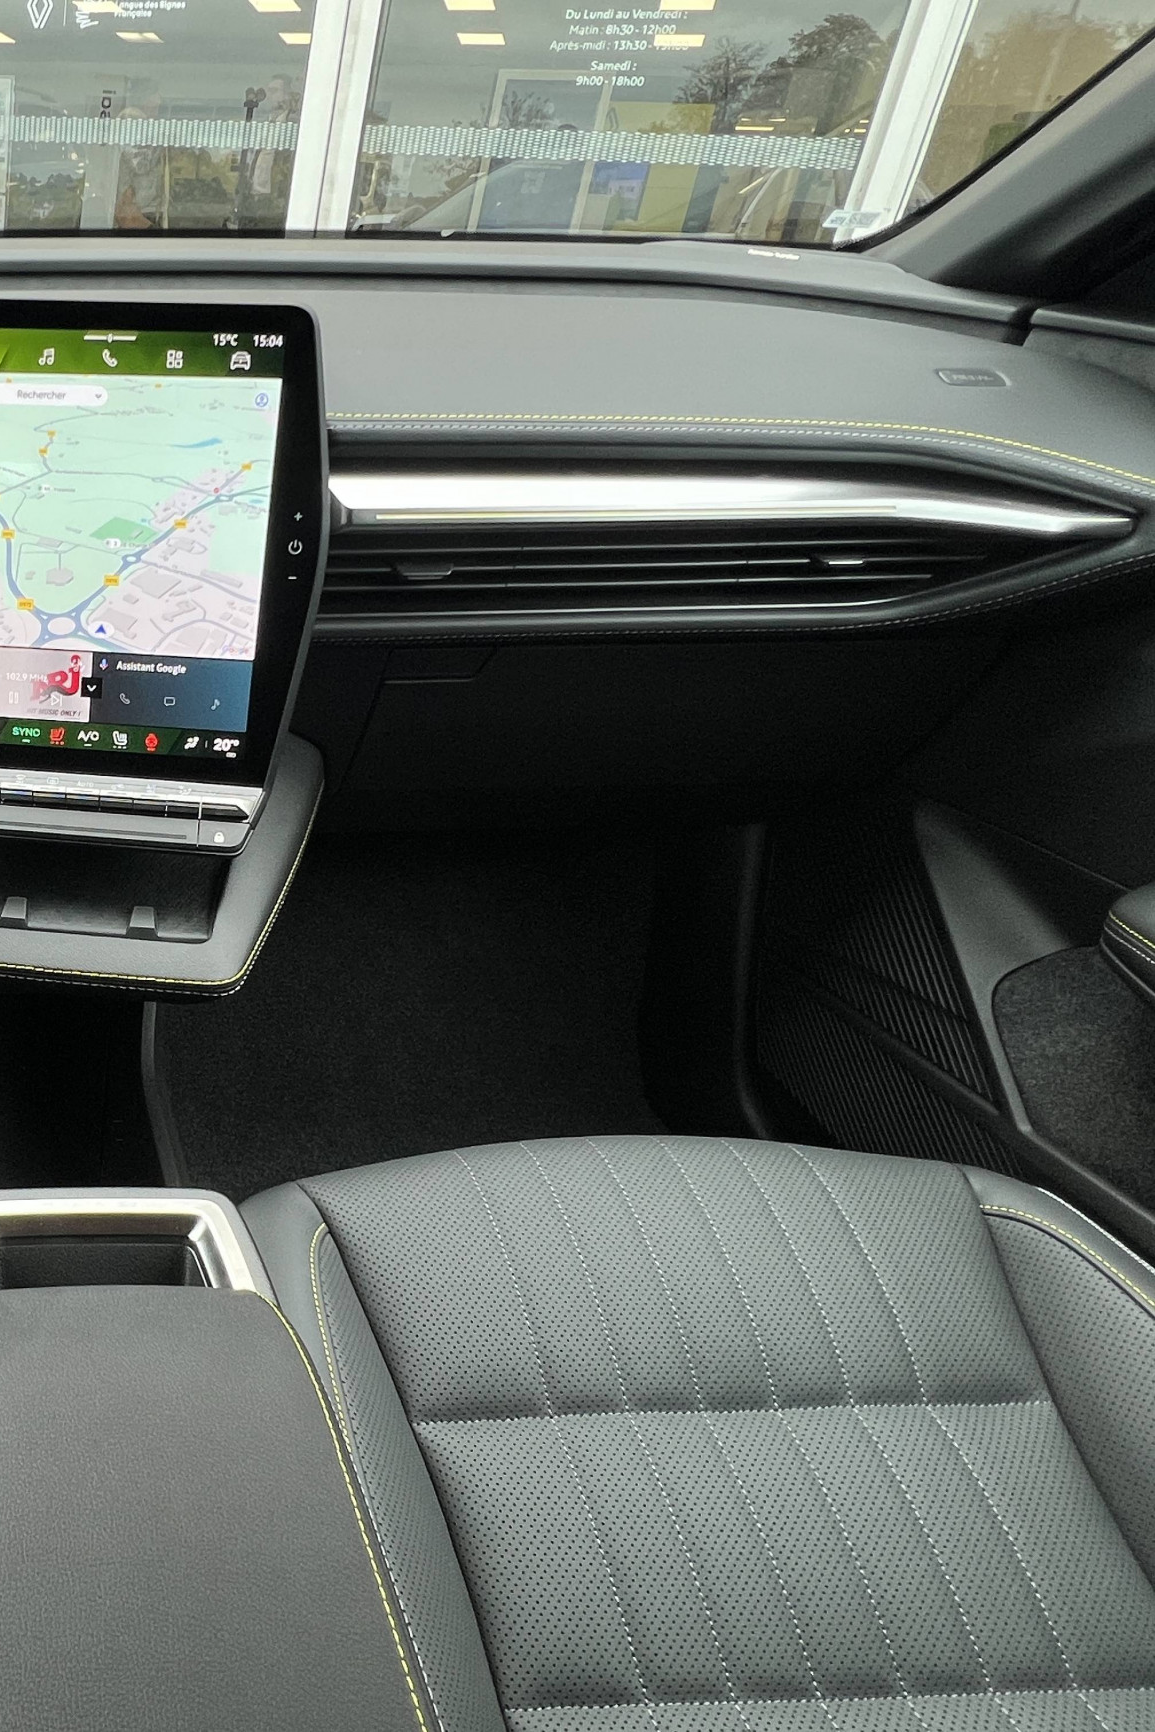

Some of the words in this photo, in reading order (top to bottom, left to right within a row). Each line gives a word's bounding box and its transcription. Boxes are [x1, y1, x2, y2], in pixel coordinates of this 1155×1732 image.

[159, 1, 186, 11] Signes
[565, 9, 581, 20] Du
[583, 9, 614, 20] Lundi
[615, 11, 630, 20] au
[632, 9, 682, 20] Vendredi
[569, 24, 599, 36] Matin
[605, 25, 634, 35] 8h30
[642, 25, 677, 35] 12h00
[550, 40, 606, 52] Après-midi
[614, 40, 647, 51] 13h30
[590, 61, 632, 71] Samedi
[575, 76, 603, 86] 9h00
[611, 76, 645, 87] 18h00
[253, 334, 284, 348] 15:04
[16, 389, 67, 399] Rechercher
[116, 660, 155, 673] Assistant
[156, 663, 187, 676] Google
[6, 672, 28, 681] 102.9
[12, 726, 41, 738] SYNC
